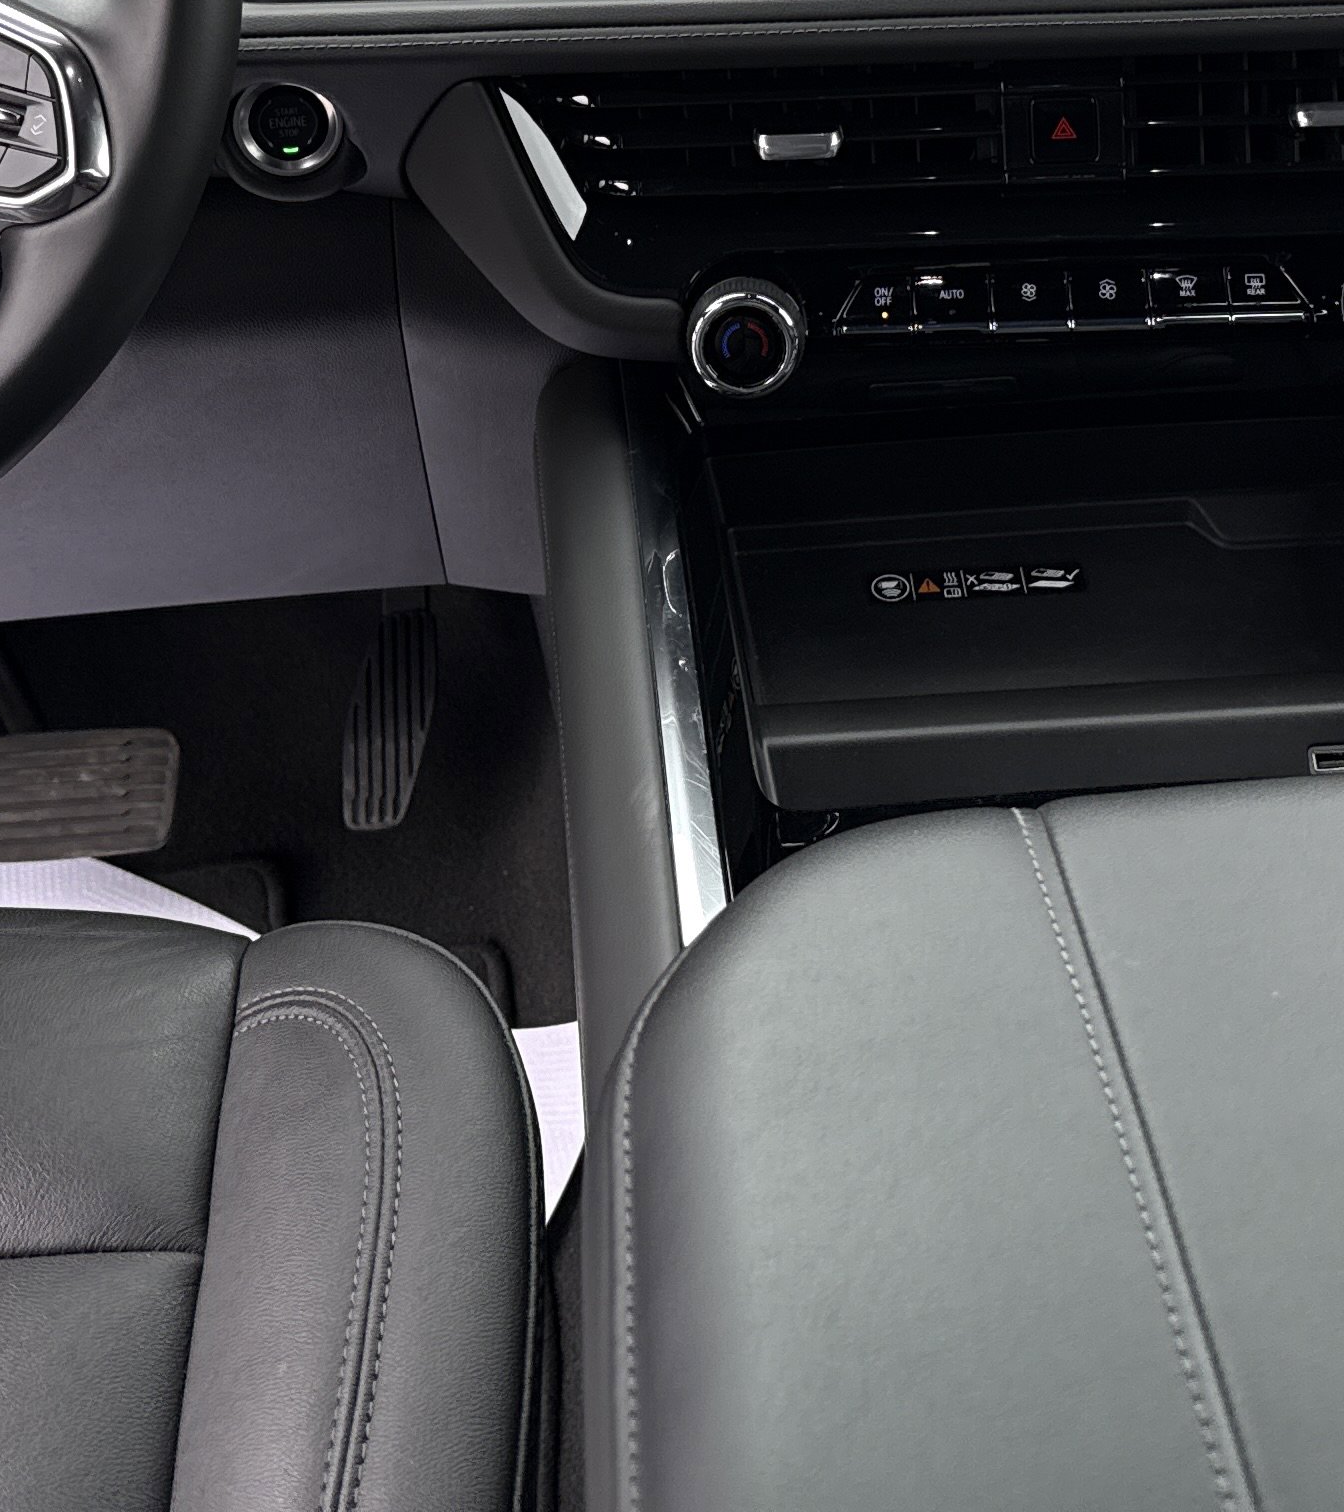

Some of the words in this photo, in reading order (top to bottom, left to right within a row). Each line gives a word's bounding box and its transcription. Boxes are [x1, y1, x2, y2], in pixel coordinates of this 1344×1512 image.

[275, 107, 299, 117] START
[269, 115, 308, 129] ENGINE
[278, 128, 300, 138] STOP
[938, 289, 965, 300] AUTO
[1179, 289, 1196, 297] MAX
[1246, 288, 1266, 296] REAR
[873, 296, 893, 307] OFF
